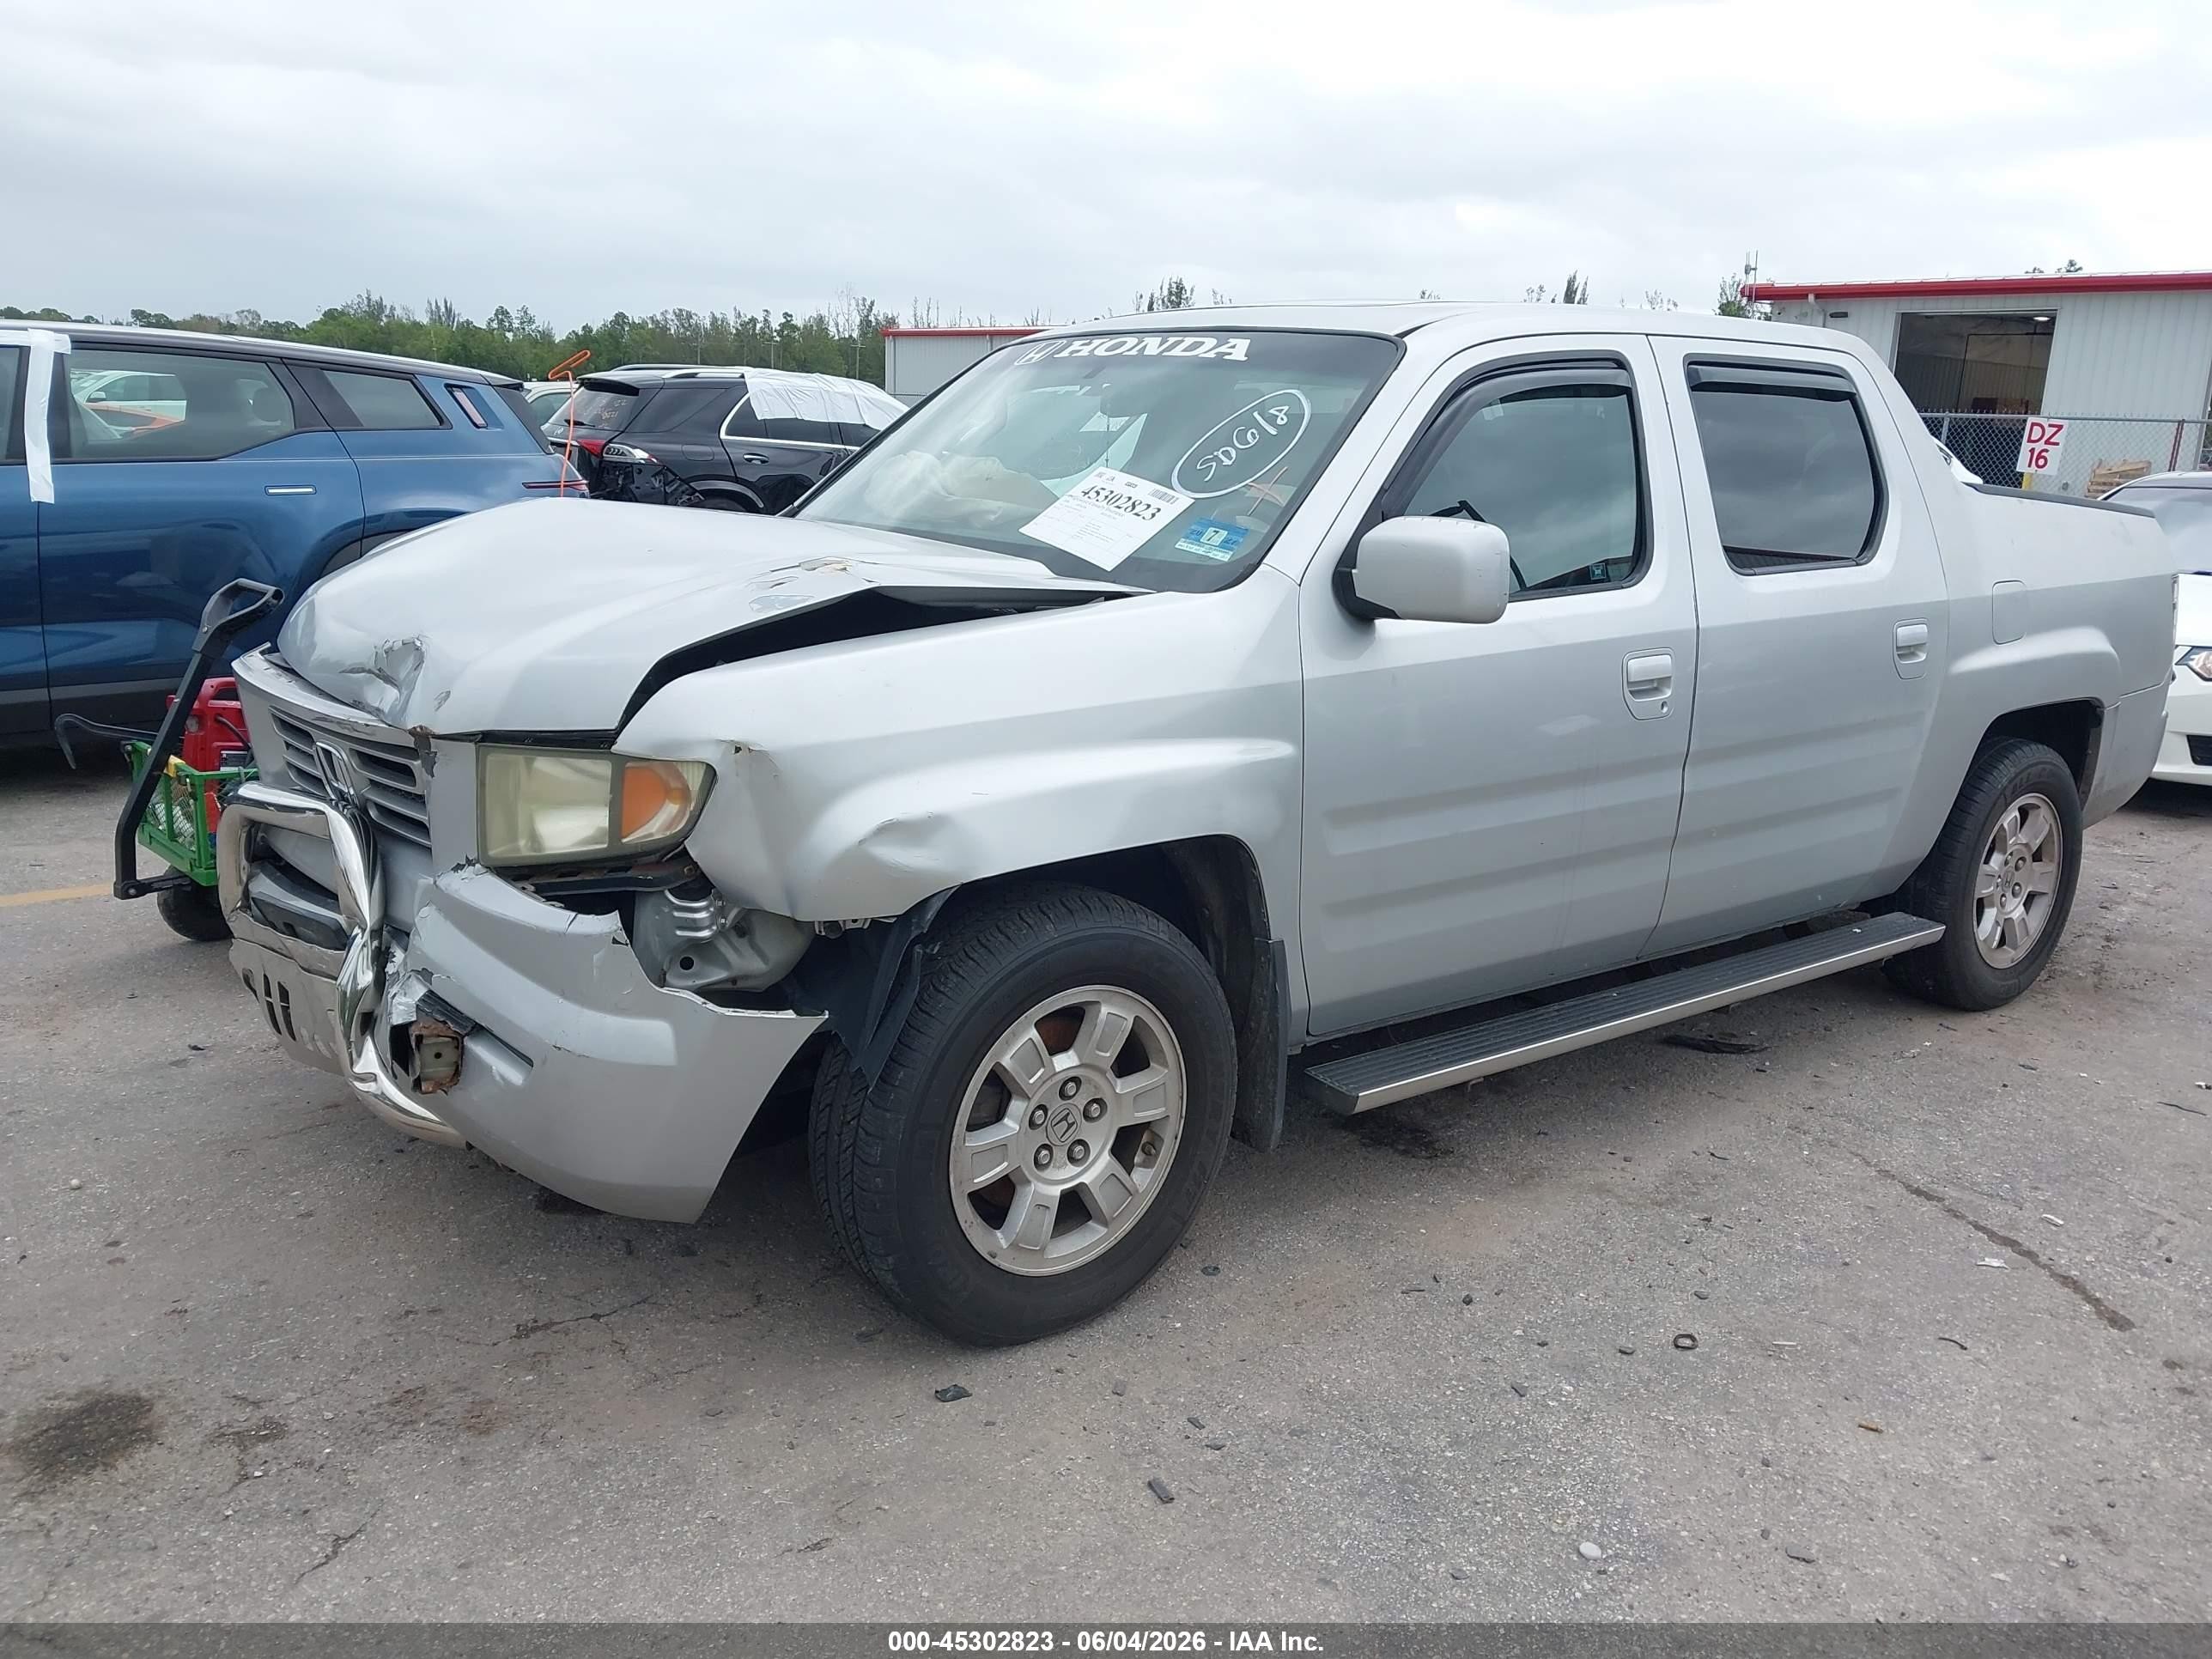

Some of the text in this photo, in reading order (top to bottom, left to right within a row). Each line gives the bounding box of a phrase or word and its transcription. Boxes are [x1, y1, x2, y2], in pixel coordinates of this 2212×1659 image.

[1054, 337, 1251, 362] HONDA
[2027, 422, 2064, 447] DZ
[2027, 447, 2050, 469] 16
[1080, 484, 1162, 521] 45302823
[1206, 530, 1220, 542] 7
